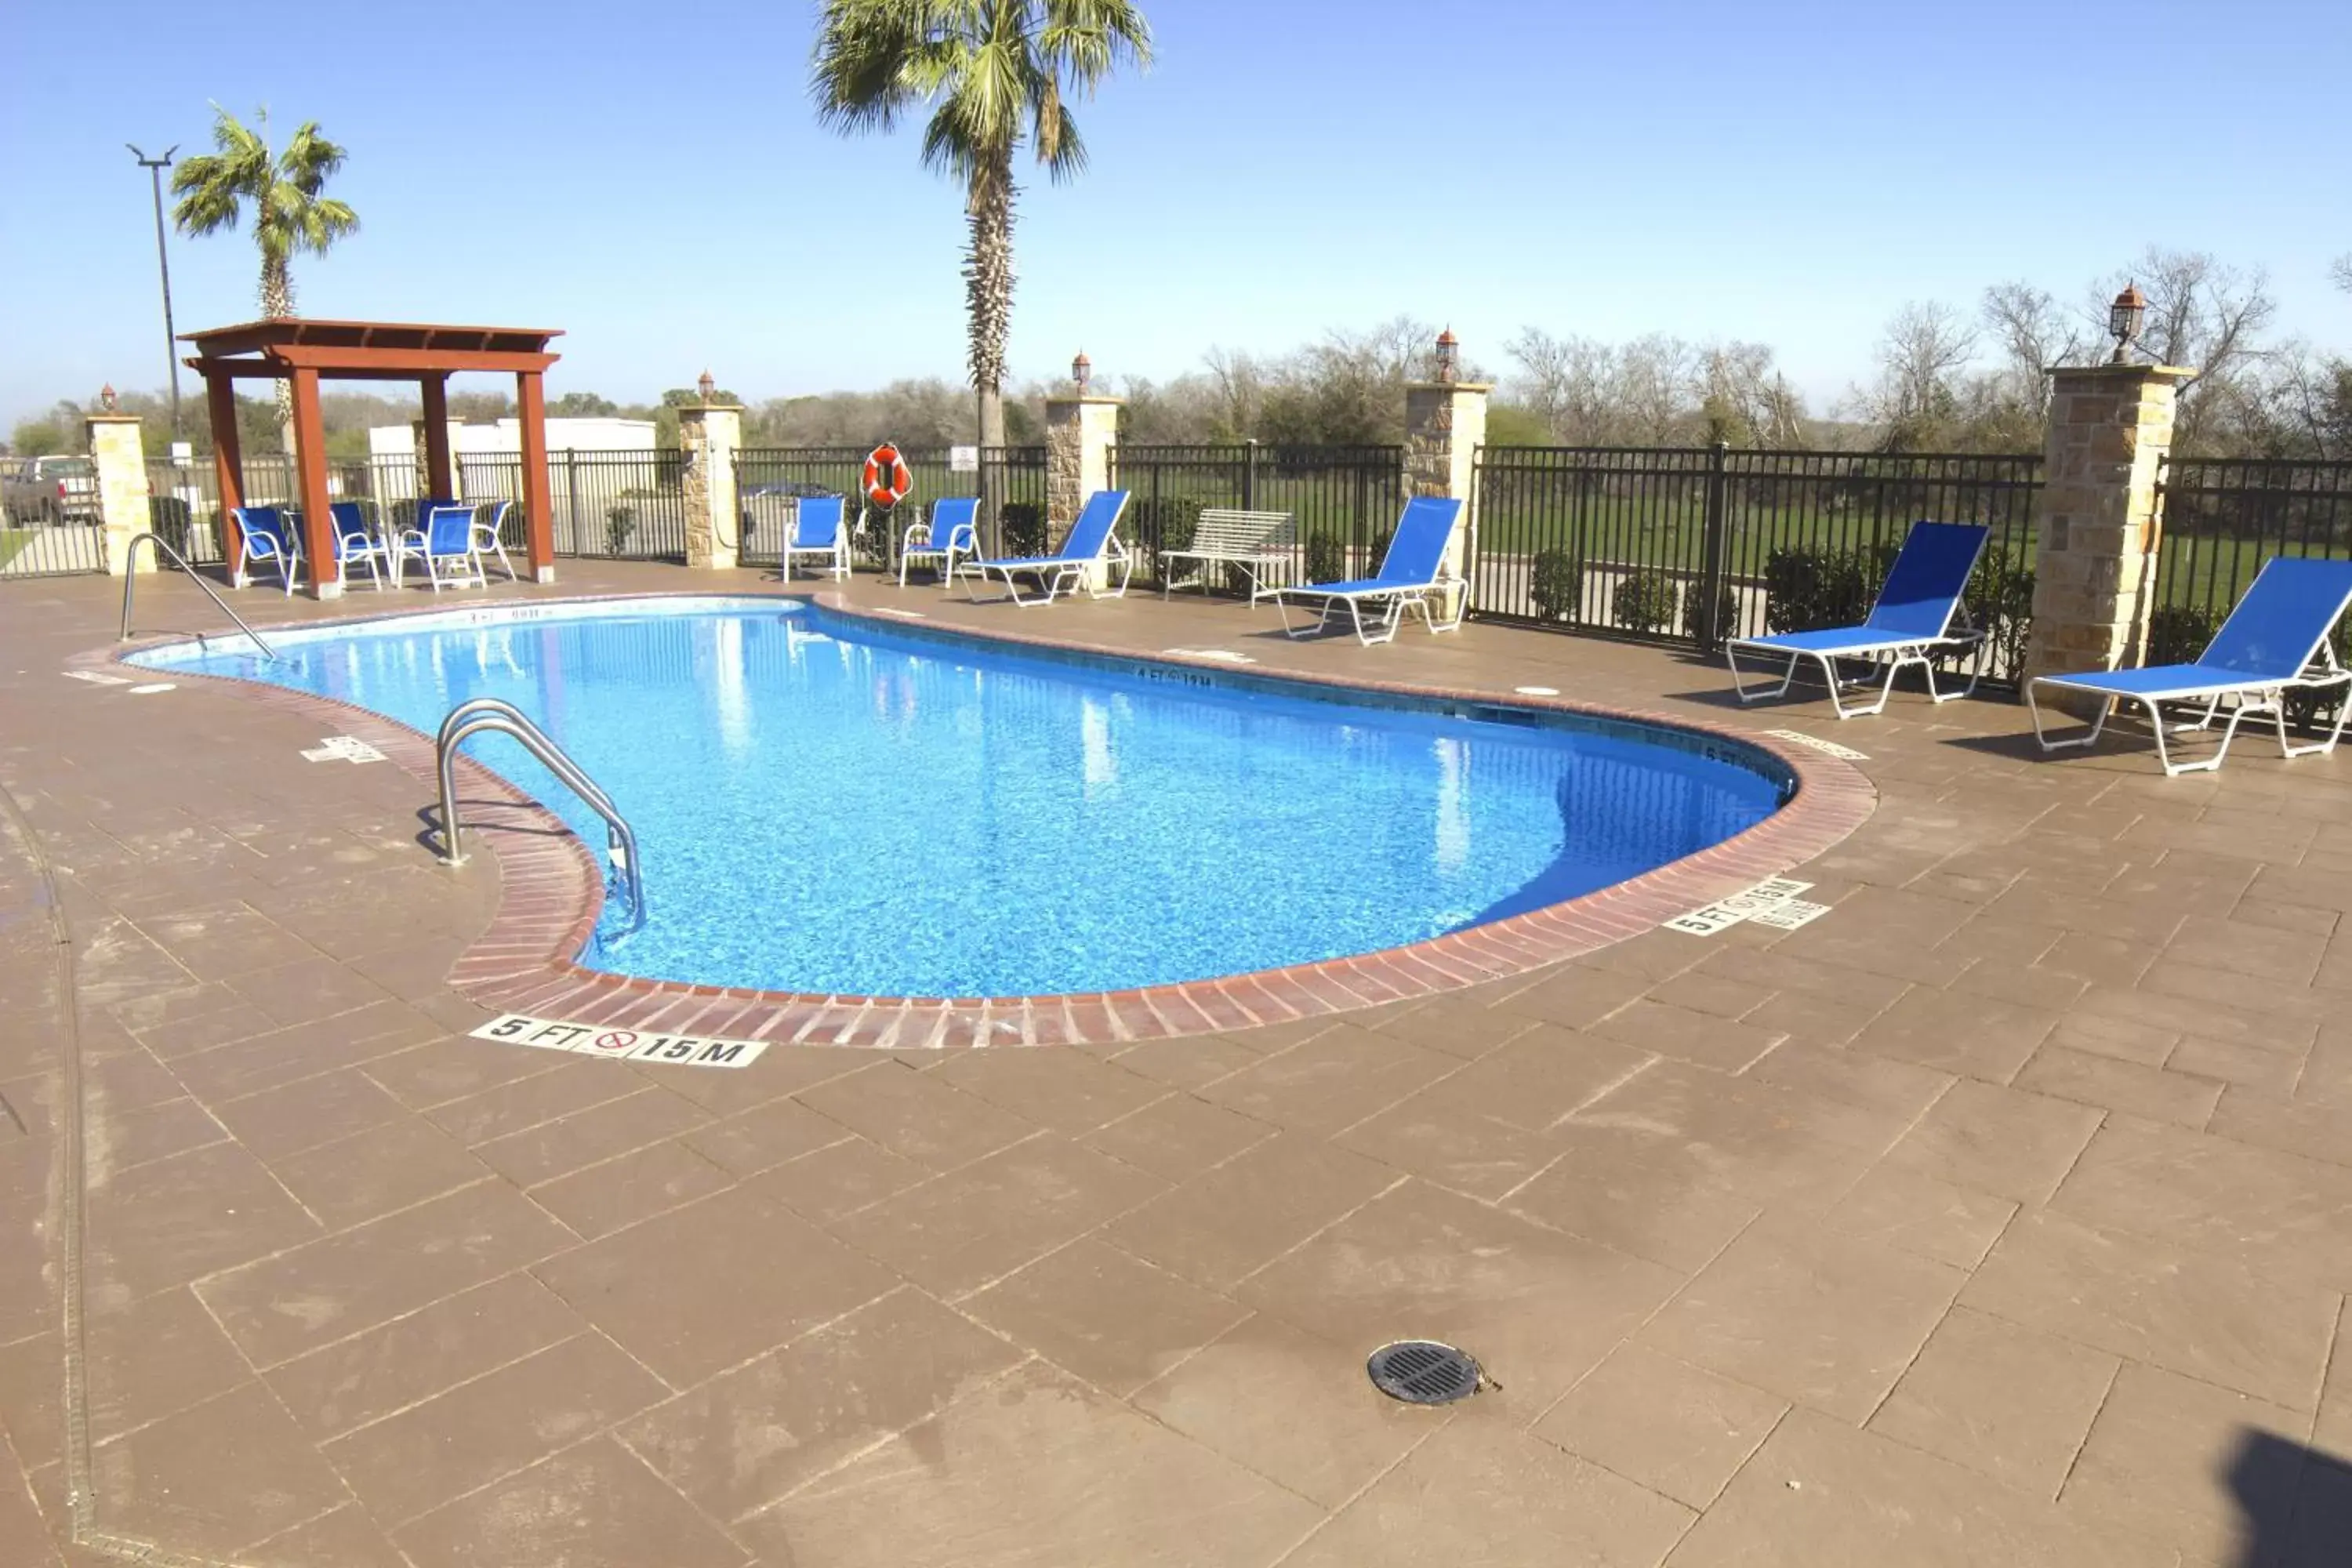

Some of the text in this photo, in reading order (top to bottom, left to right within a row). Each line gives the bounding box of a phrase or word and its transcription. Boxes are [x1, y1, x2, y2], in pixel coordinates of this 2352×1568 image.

[1675, 918, 1713, 931] 5
[1696, 906, 1740, 924] FT
[490, 1018, 532, 1037] 5
[528, 1024, 593, 1046] FT
